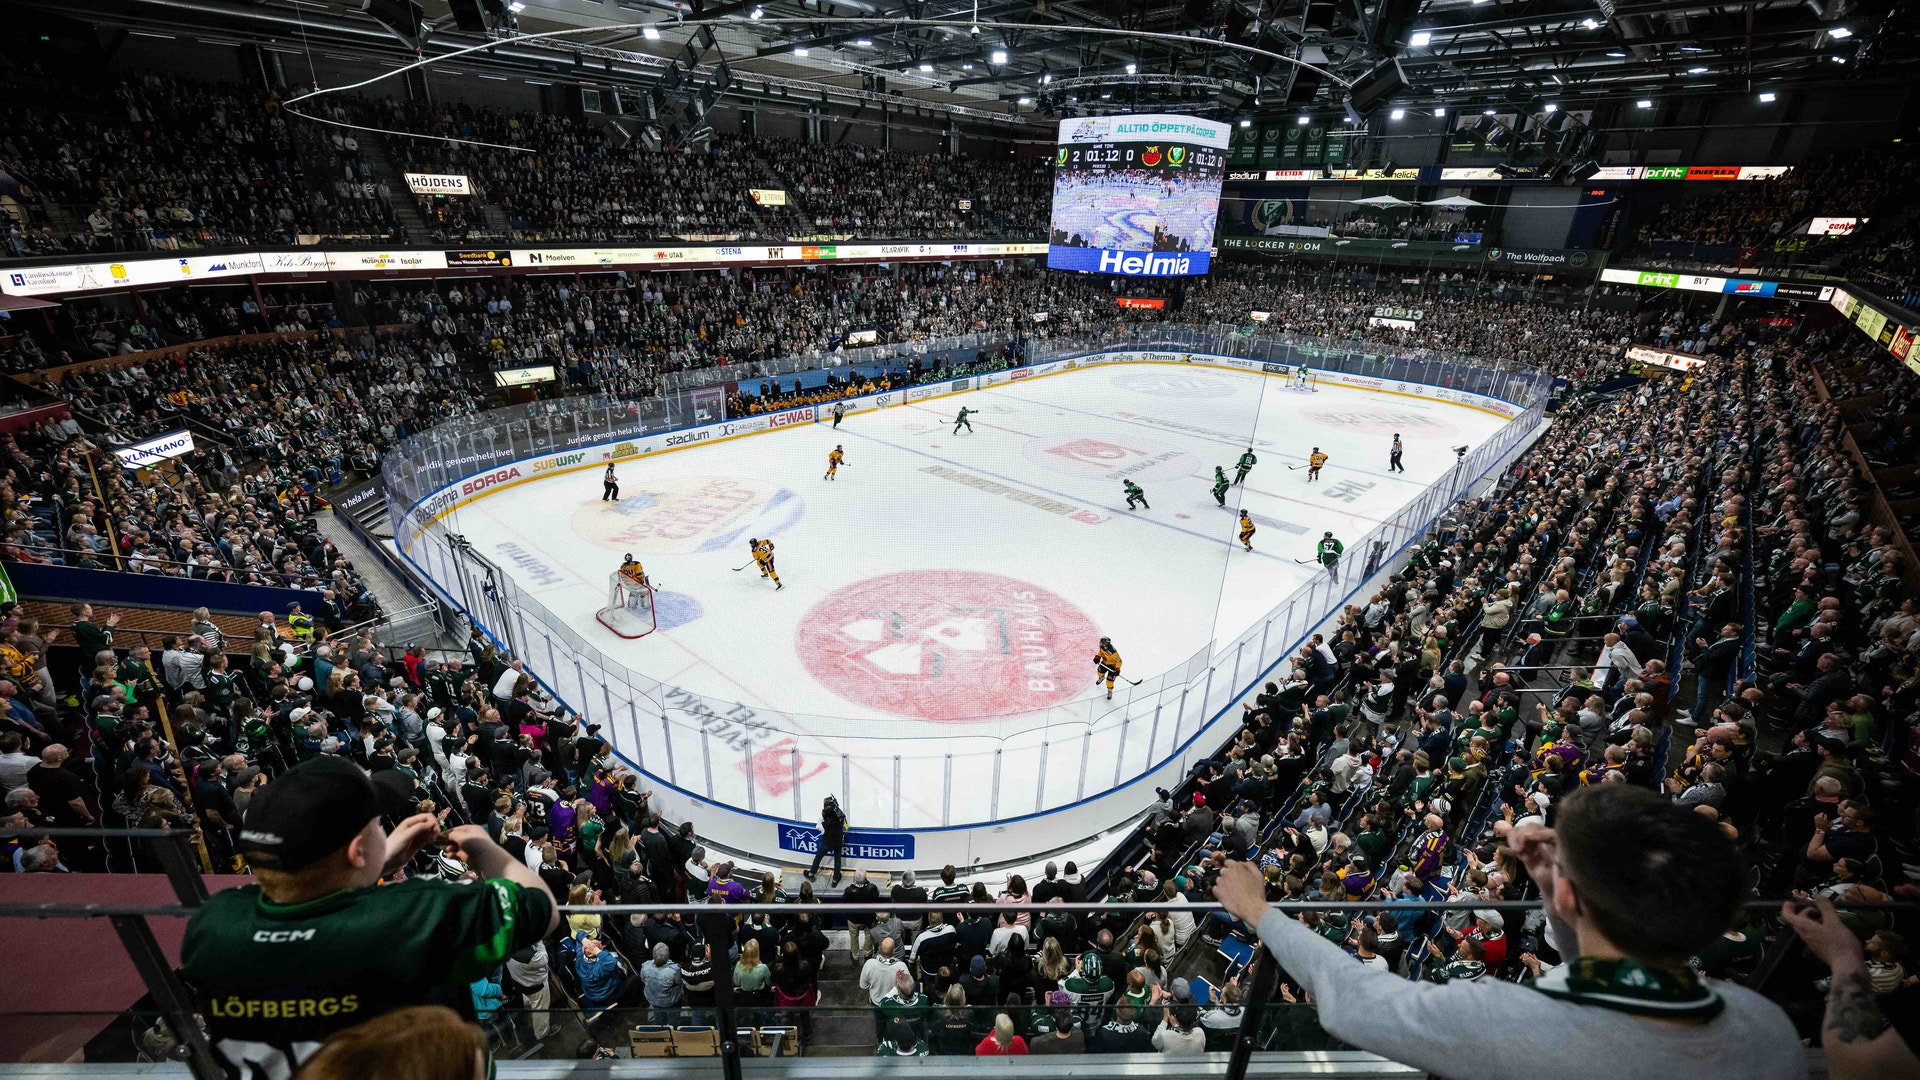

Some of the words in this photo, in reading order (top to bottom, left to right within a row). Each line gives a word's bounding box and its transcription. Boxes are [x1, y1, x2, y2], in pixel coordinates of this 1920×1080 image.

[1117, 123, 1149, 133] ALLTID
[1152, 121, 1186, 134] ÖPPET
[1186, 124, 1196, 135] PÅ
[1073, 151, 1080, 162] 2
[1086, 150, 1119, 162] 01:12
[1126, 150, 1134, 161] 0
[1188, 153, 1194, 164] 2
[1197, 153, 1216, 167] 01:12
[1217, 157, 1223, 167] 0
[1229, 171, 1260, 180] stadium
[1646, 168, 1684, 179] print
[411, 175, 463, 187] HÖJDENS
[721, 247, 742, 255] STENA
[1223, 238, 1242, 247] THE
[1245, 240, 1285, 249] LOCKER
[1288, 242, 1321, 251] ROOM
[768, 247, 784, 258] NWT
[1506, 252, 1522, 260] The
[1524, 253, 1566, 263] Wolfpack
[229, 259, 262, 270] Munkfors
[401, 257, 423, 265] Isolar
[1099, 250, 1190, 275] Helmia
[1642, 273, 1675, 286] print
[1693, 277, 1709, 285] BVT
[1374, 307, 1393, 317] 20
[1406, 309, 1424, 320] 13
[1342, 376, 1383, 387] Budpartner
[769, 408, 813, 428] KEWAB
[592, 430, 617, 442] genom
[617, 428, 632, 436] hela
[666, 430, 710, 447] stadium
[446, 456, 476, 468] genom
[476, 452, 495, 461] hela
[496, 448, 514, 458] livet
[532, 452, 586, 473] SUBWAY
[462, 467, 522, 496] BORGA
[347, 494, 362, 508] hela
[361, 487, 376, 500] livet
[1323, 479, 1377, 504] SHL
[414, 488, 459, 524] ByggTema
[1012, 590, 1057, 693] BAUHAUS
[665, 686, 748, 752] SVENSKA
[727, 701, 774, 740] SPEL
[527, 800, 546, 817] 73
[798, 840, 817, 852] AB
[864, 846, 905, 858] HEDIN
[253, 928, 317, 943] CCM
[212, 995, 359, 1019] LÖFBERGS
